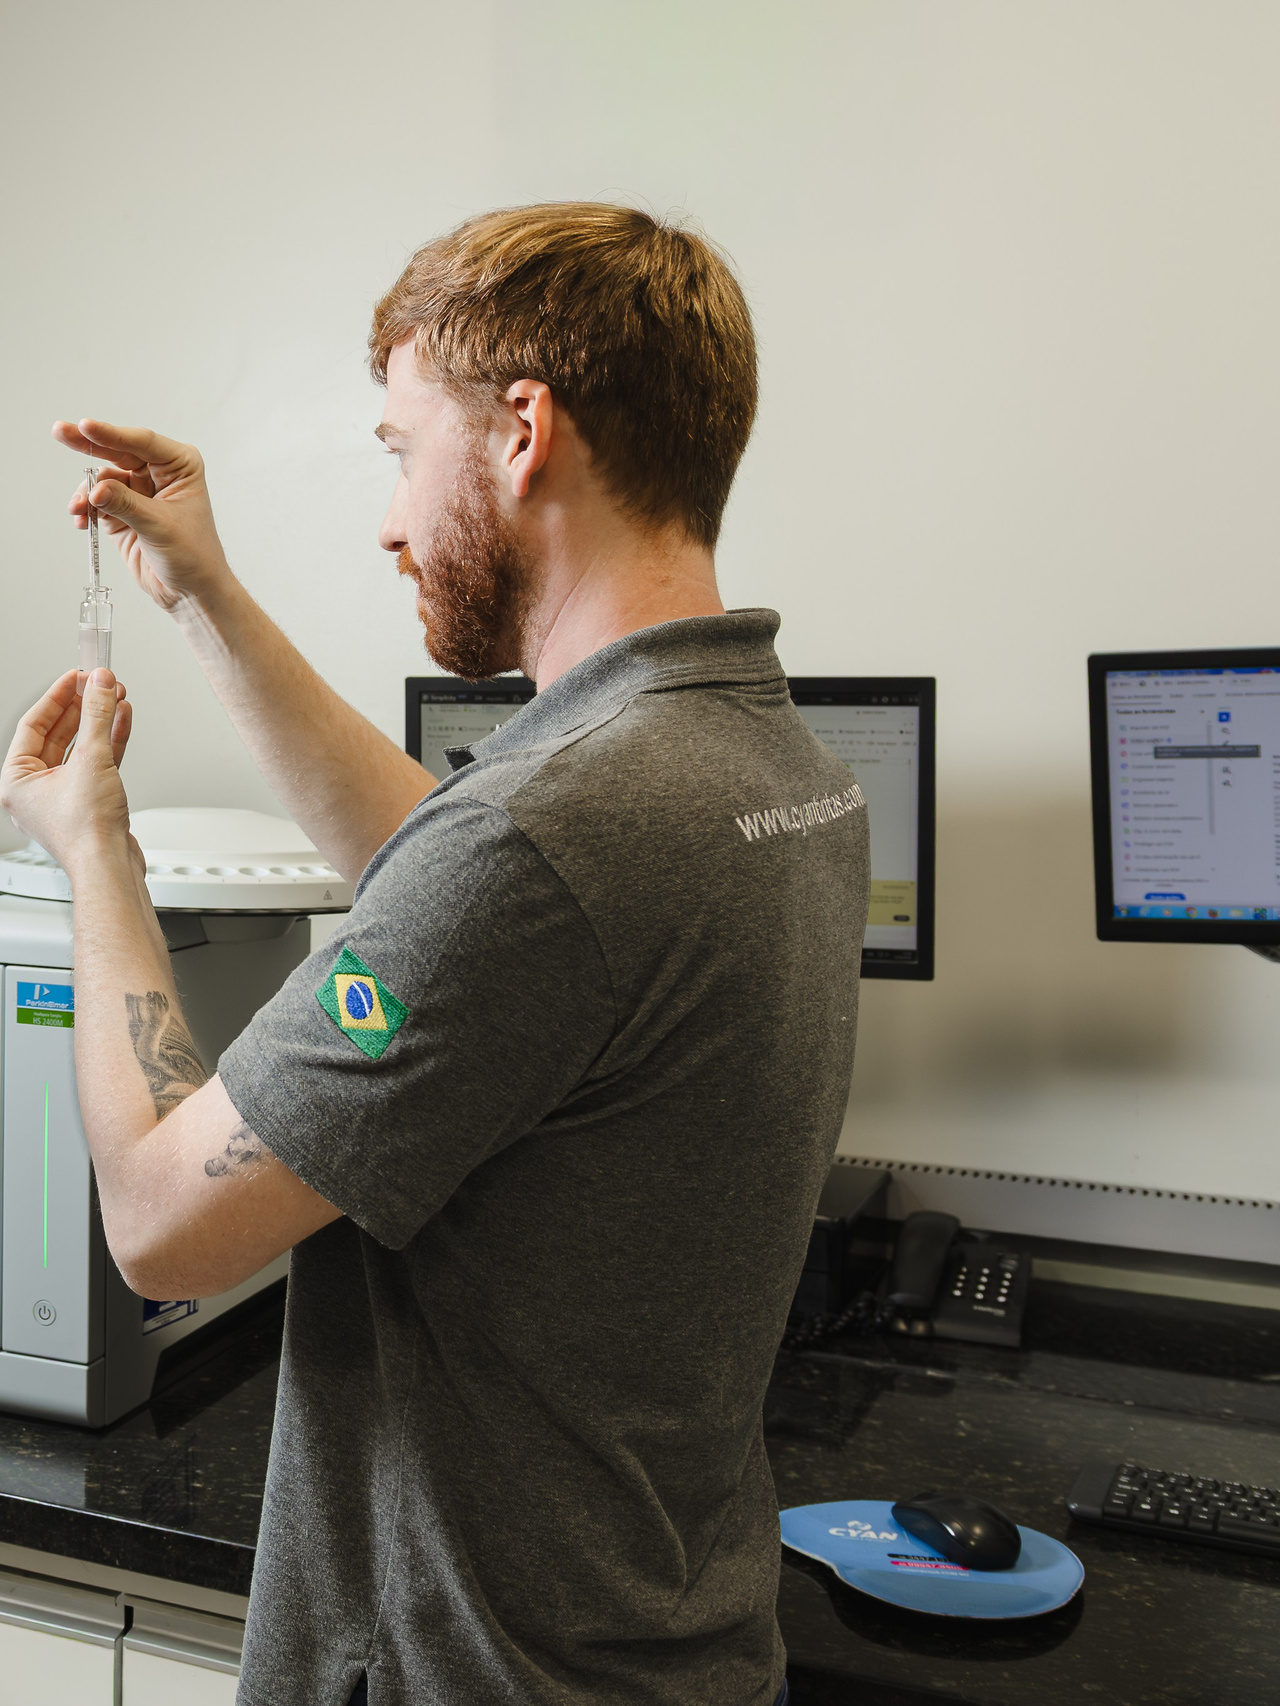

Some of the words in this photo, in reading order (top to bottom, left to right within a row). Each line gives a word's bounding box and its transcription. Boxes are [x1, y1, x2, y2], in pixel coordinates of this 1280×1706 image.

[26, 999, 69, 1009] PerkinElmer
[33, 1017, 42, 1025] HS
[828, 1527, 898, 1540] CYAN
